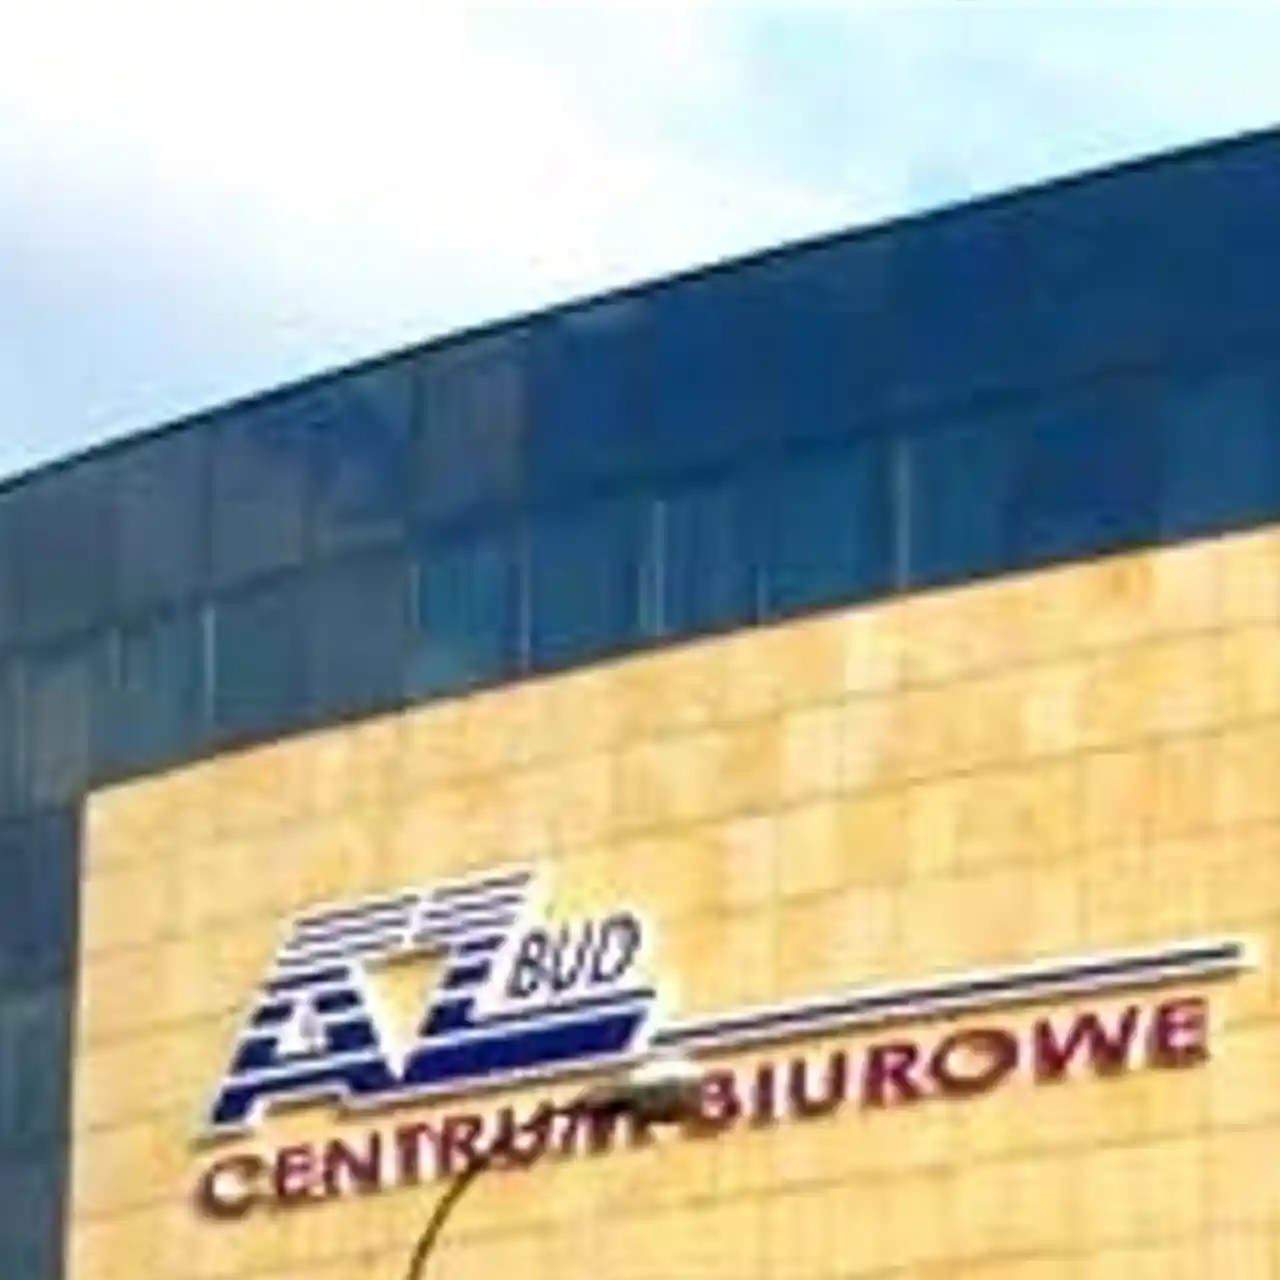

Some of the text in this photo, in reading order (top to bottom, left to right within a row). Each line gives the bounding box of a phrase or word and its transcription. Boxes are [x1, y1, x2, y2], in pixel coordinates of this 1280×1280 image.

[505, 908, 644, 1002] BUD
[194, 997, 1211, 1222] CENTRUM BIUROWE
